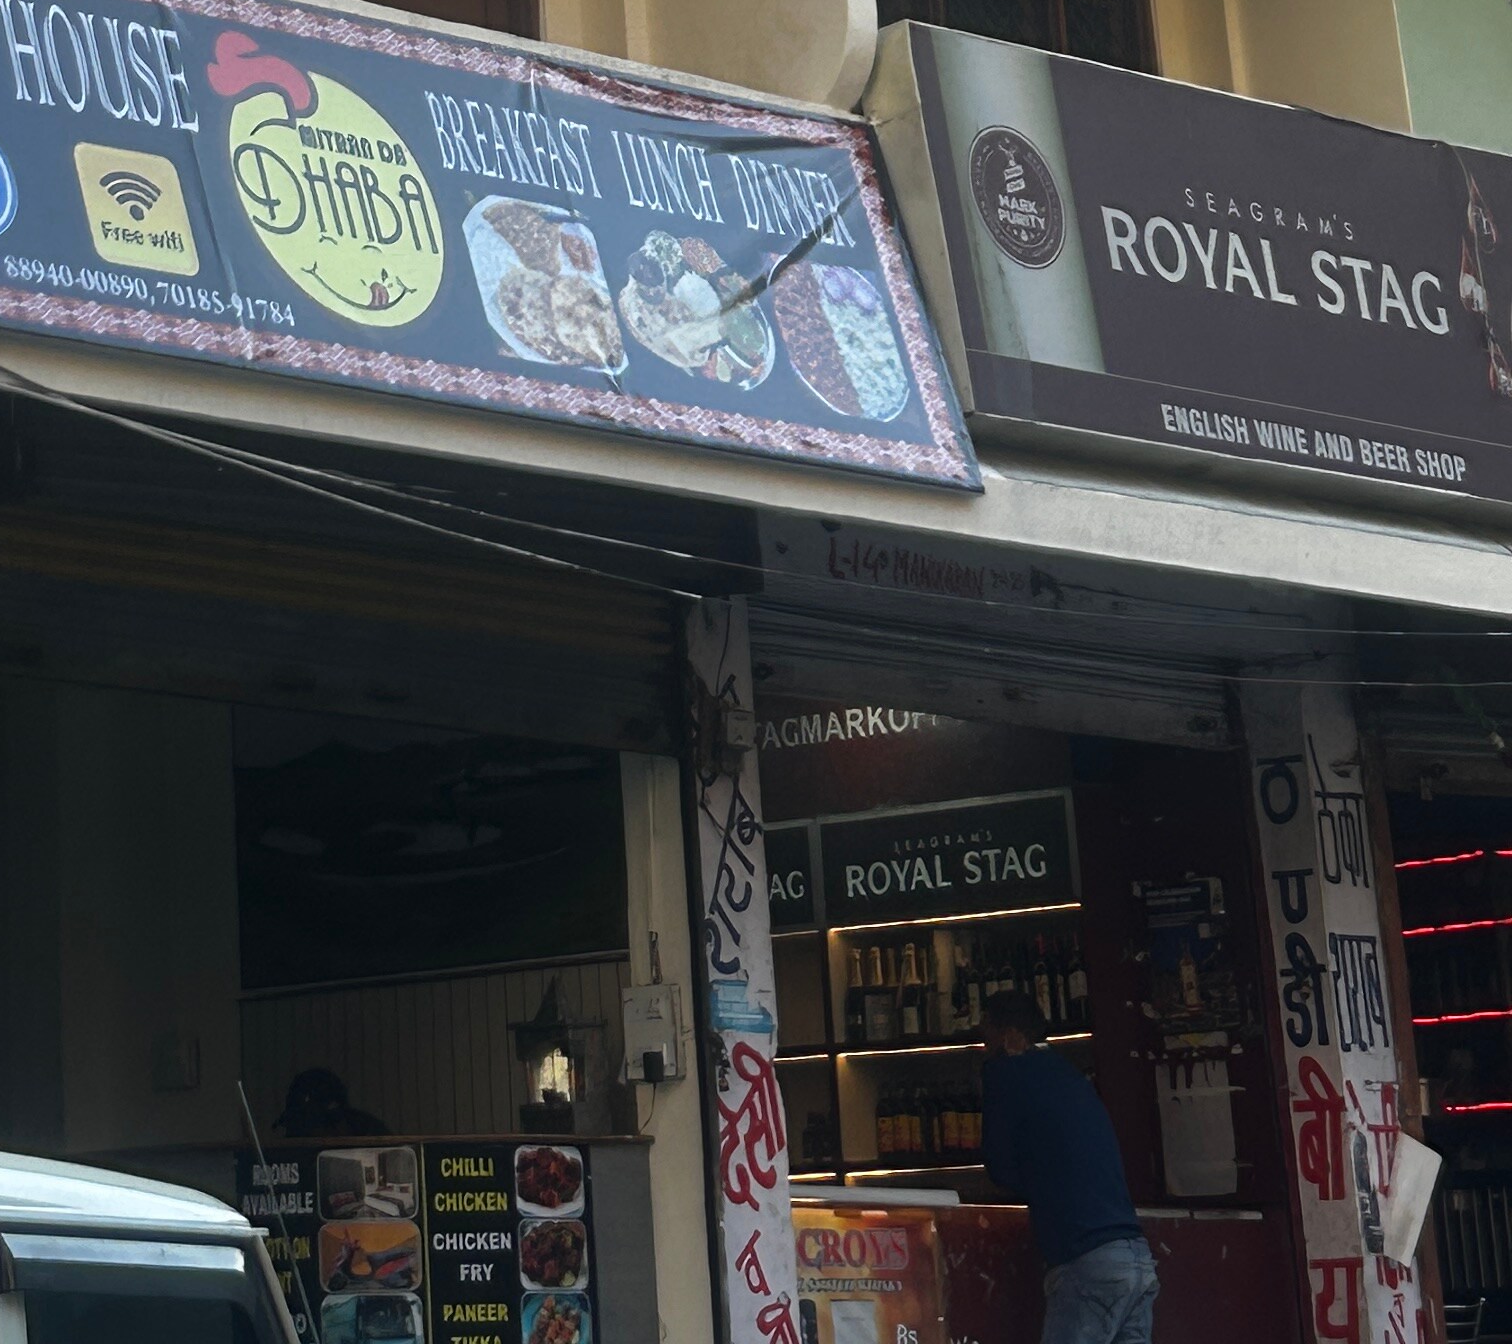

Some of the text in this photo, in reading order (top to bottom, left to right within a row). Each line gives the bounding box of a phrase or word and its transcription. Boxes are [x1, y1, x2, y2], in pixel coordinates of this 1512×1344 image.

[424, 90, 857, 248] BREAKFAST LUNCH DINNER
[233, 142, 438, 254] DHABA
[1184, 188, 1354, 240] SEAGRAM'S
[100, 220, 144, 247] Free
[1101, 205, 1450, 335] ROYAL STAG
[1161, 404, 1467, 482] ENGLISH WINE AND BEER SHOP
[845, 843, 1048, 900] ROYAL STAG
[440, 1157, 495, 1178] CHILLI
[434, 1191, 508, 1212] CHICKEN
[433, 1231, 512, 1252] CHICKEN
[459, 1263, 495, 1282] FRY
[443, 1303, 509, 1322] PANEER
